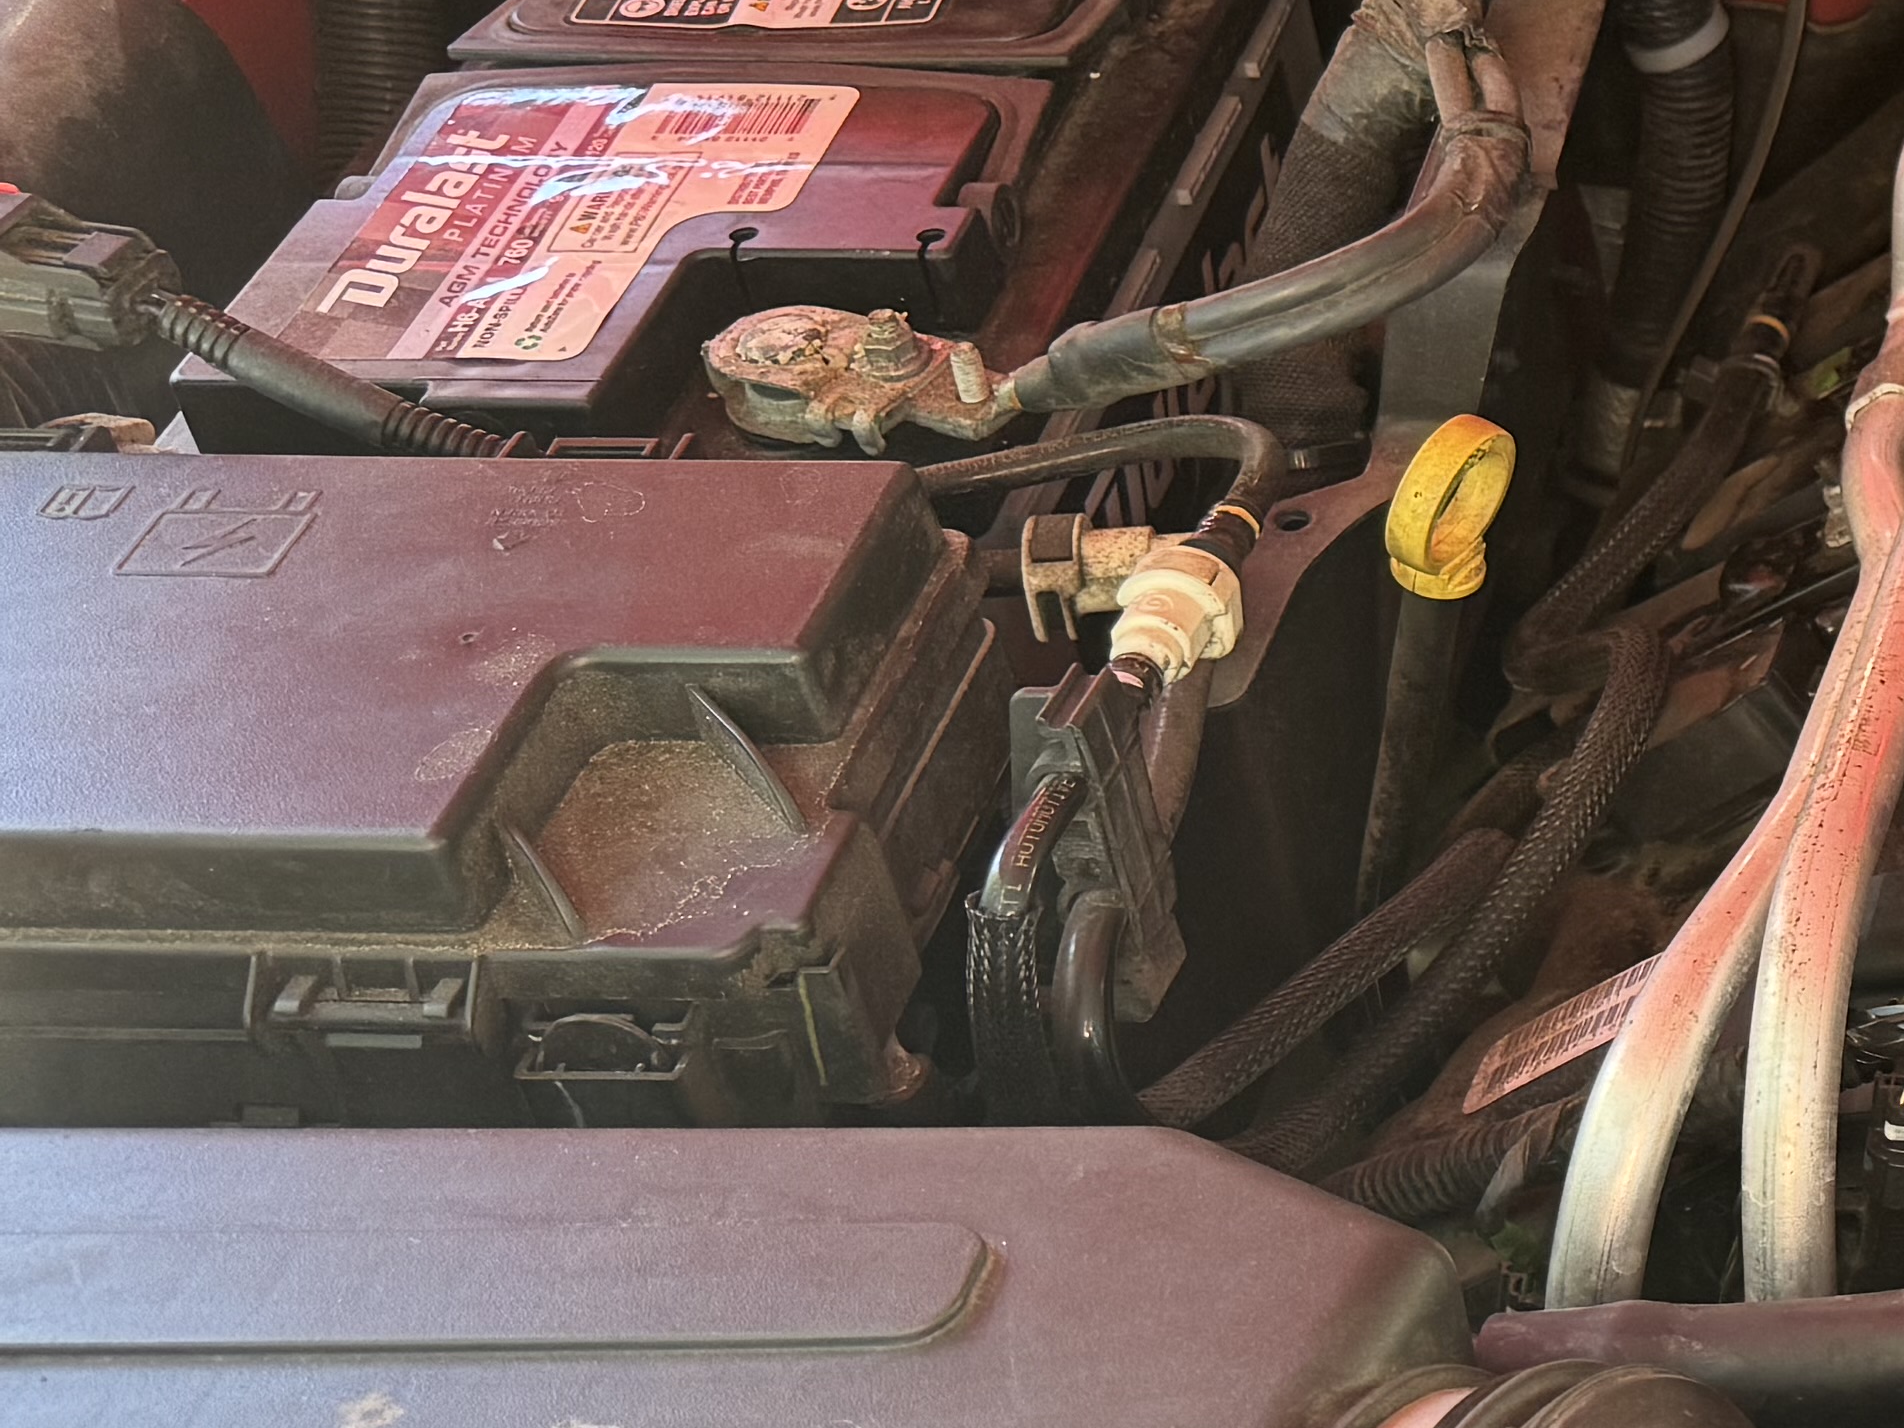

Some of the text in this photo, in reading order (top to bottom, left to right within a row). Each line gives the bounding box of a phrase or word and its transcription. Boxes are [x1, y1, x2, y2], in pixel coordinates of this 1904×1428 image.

[316, 129, 511, 313] Duralast
[443, 135, 537, 242] PLATINM
[438, 262, 482, 309] AGM
[497, 239, 533, 266] 760
